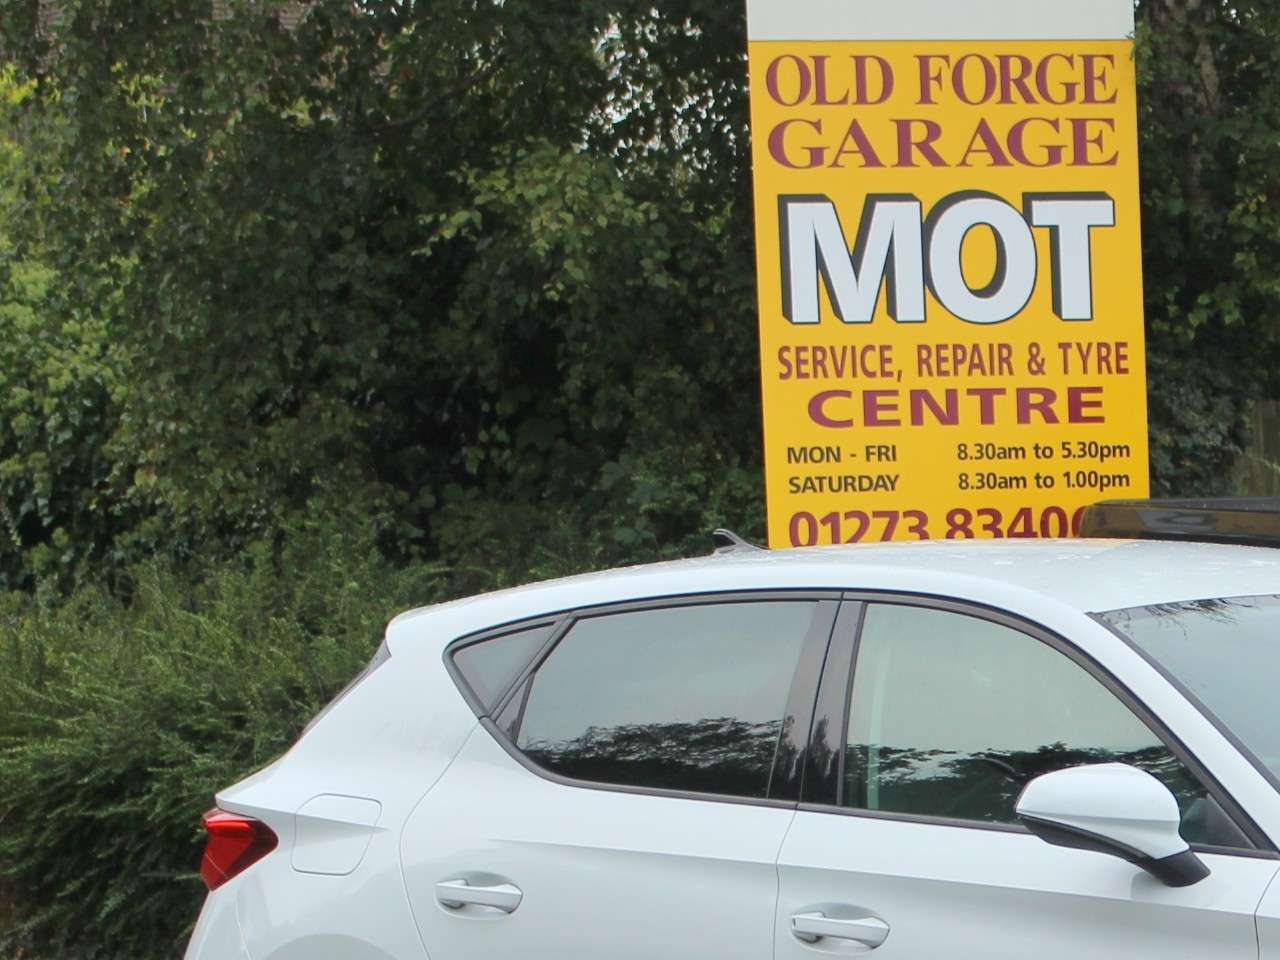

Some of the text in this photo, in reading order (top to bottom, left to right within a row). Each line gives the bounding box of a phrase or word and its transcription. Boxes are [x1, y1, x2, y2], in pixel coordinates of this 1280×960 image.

[766, 53, 1119, 106] OLD FORGE
[767, 117, 1119, 169] GARAGE
[777, 189, 1115, 324] MOT
[778, 341, 1130, 382] SERVICE, REPAIR & TYRE
[807, 386, 1106, 428] CENTRE
[787, 446, 841, 464] MON
[865, 444, 897, 462] FRI
[957, 442, 1026, 460] 8.30am
[1033, 442, 1054, 459] to
[1061, 441, 1131, 462] 5.30pm
[789, 471, 1131, 494] SATURDAY 8.30am to 1.00pm
[789, 509, 930, 547] 01273
